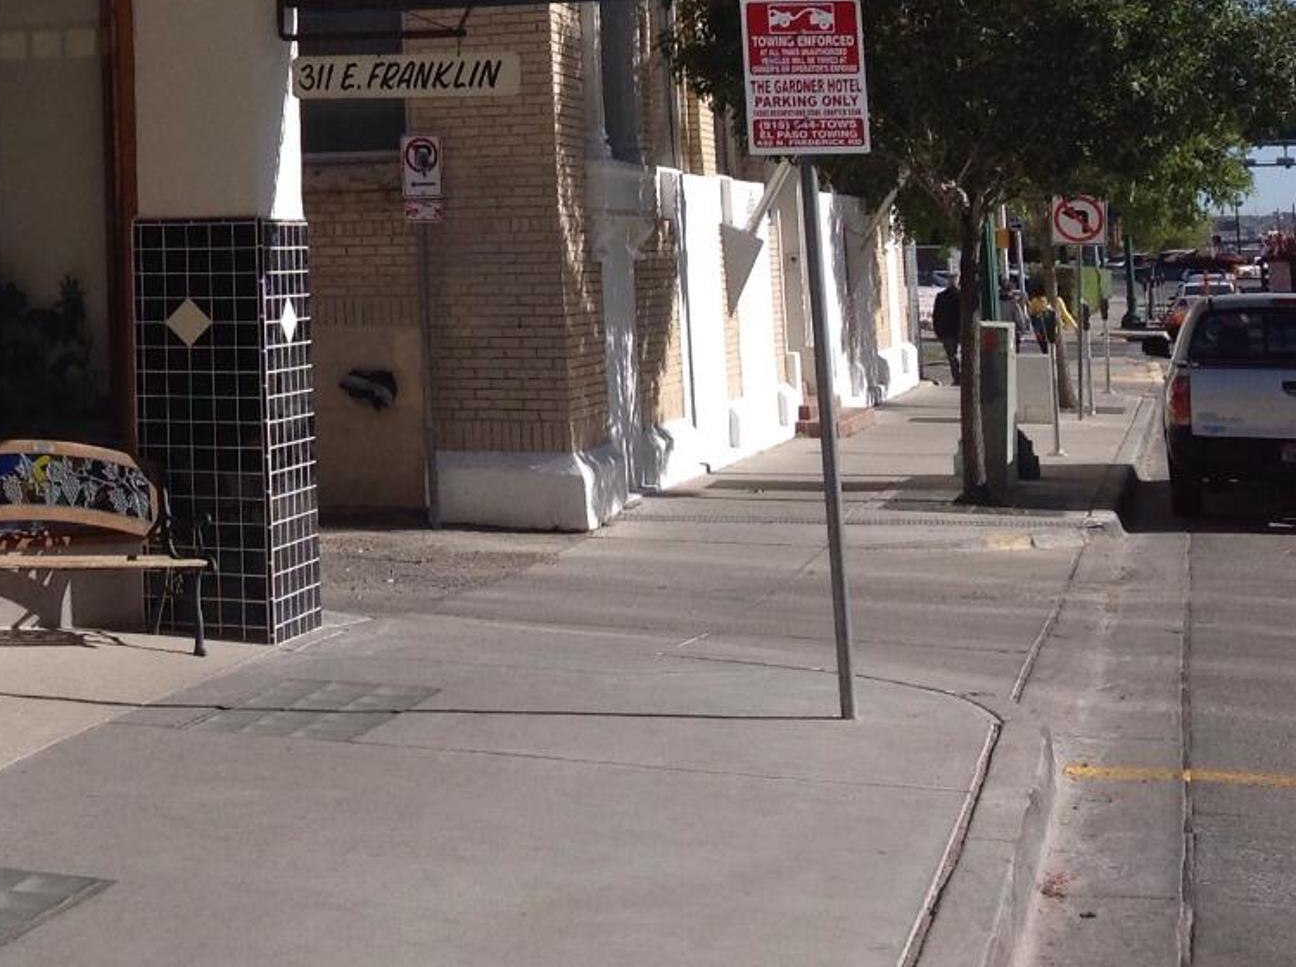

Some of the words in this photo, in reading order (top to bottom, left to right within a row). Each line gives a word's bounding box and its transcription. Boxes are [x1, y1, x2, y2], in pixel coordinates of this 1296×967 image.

[752, 36, 795, 47] TOWING
[797, 35, 855, 46] ENFORCED
[299, 63, 334, 91] 311
[340, 63, 361, 91] E.
[368, 60, 502, 90] FRANKLIN
[750, 80, 771, 94] THE
[774, 80, 824, 94] GARDNER
[828, 79, 862, 93] HOTEL
[755, 95, 817, 107] PARKING
[822, 95, 859, 107] ONLY
[759, 130, 774, 139] EL
[777, 130, 808, 139] PASO
[812, 130, 858, 138] TOWING
